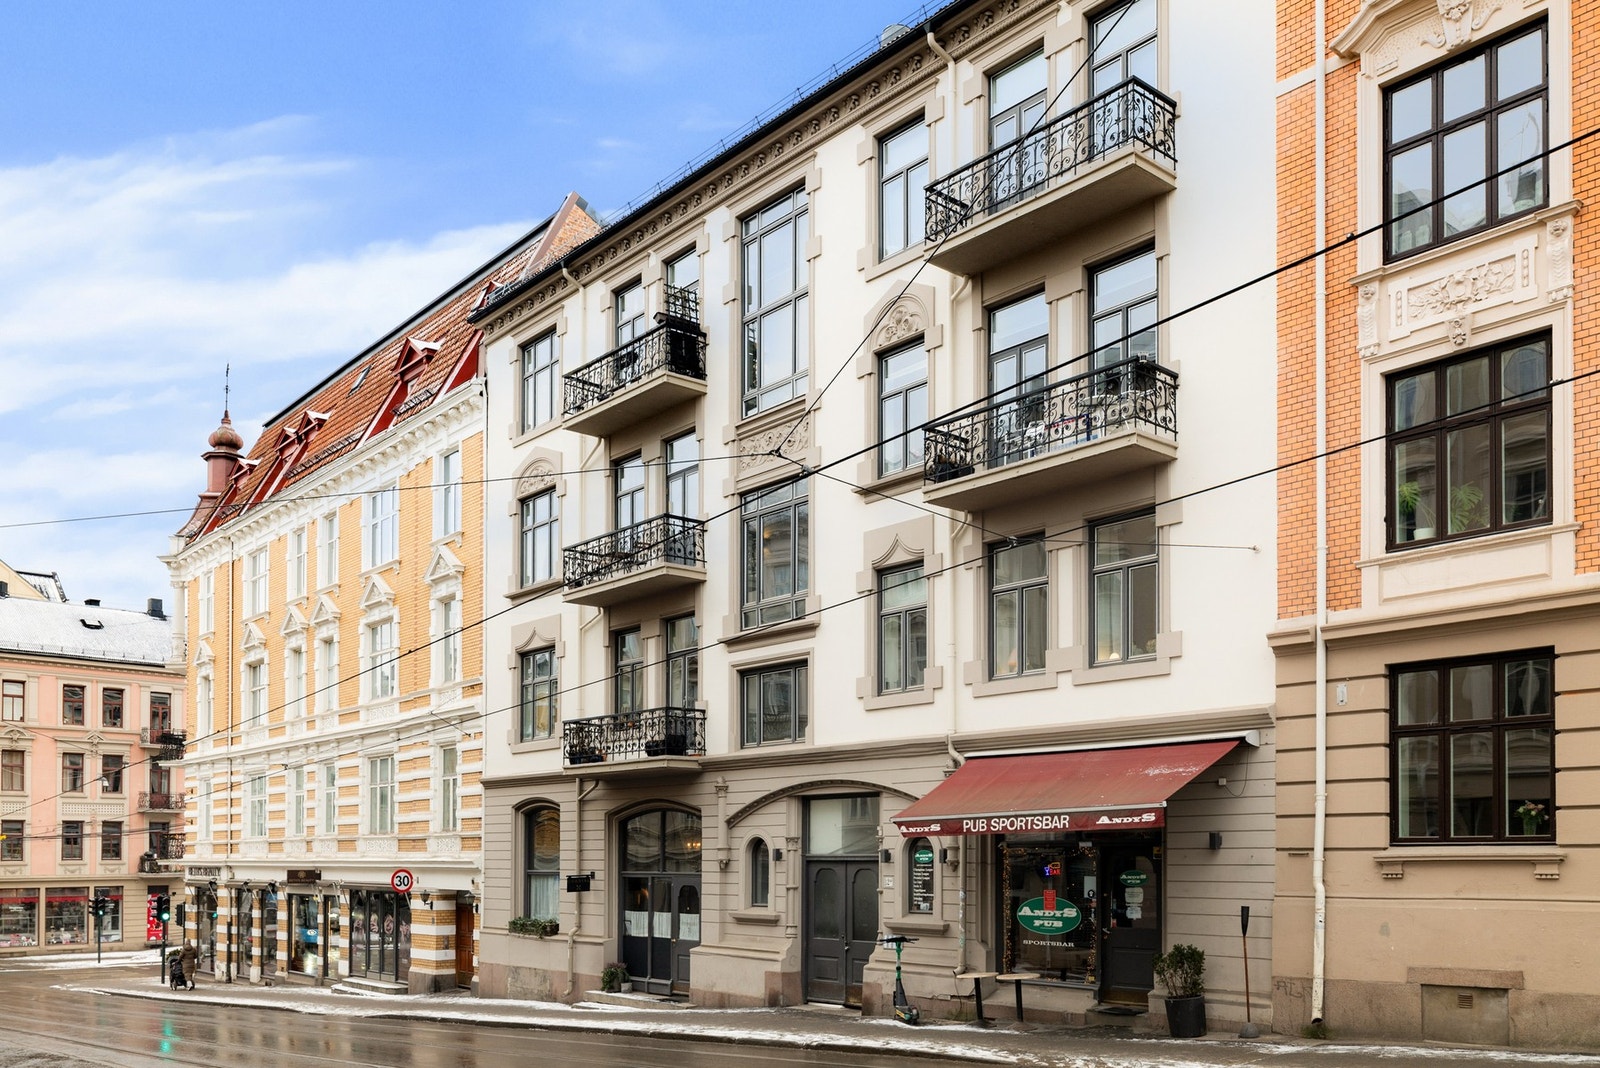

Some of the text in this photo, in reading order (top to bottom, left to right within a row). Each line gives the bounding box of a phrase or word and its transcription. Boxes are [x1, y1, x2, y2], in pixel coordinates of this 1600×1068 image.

[963, 815, 1070, 832] PUB SPORTSBAR
[395, 875, 410, 887] 30
[1033, 920, 1063, 928] PUB
[1023, 940, 1075, 948] SPORTSBAR
